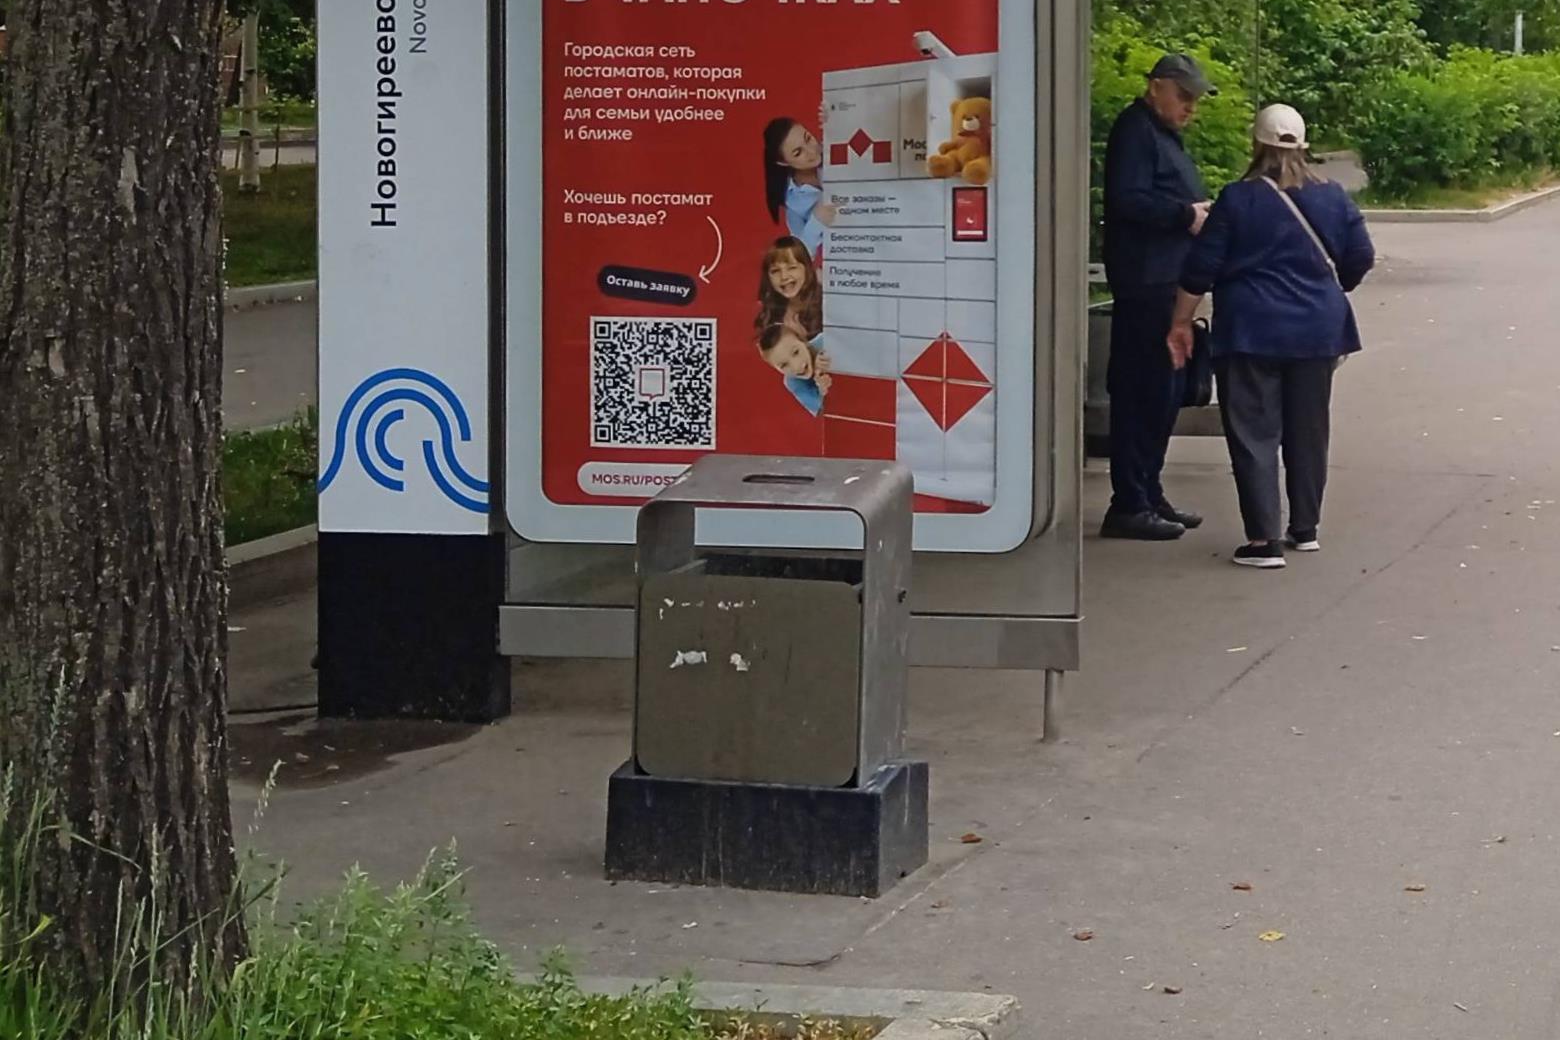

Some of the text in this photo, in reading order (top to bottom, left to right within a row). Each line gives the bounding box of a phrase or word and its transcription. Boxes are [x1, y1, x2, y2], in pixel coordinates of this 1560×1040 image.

[564, 42, 696, 59] Городская сеть
[564, 65, 742, 82] постаматов, которая
[563, 84, 766, 104] делает онлайн-покупки
[563, 105, 725, 123] для семьи удобнее
[564, 125, 633, 141] и ближе
[564, 189, 714, 206] Хочешь постамат
[563, 209, 668, 227] в подъезде?
[606, 274, 691, 298] Оставь заявку
